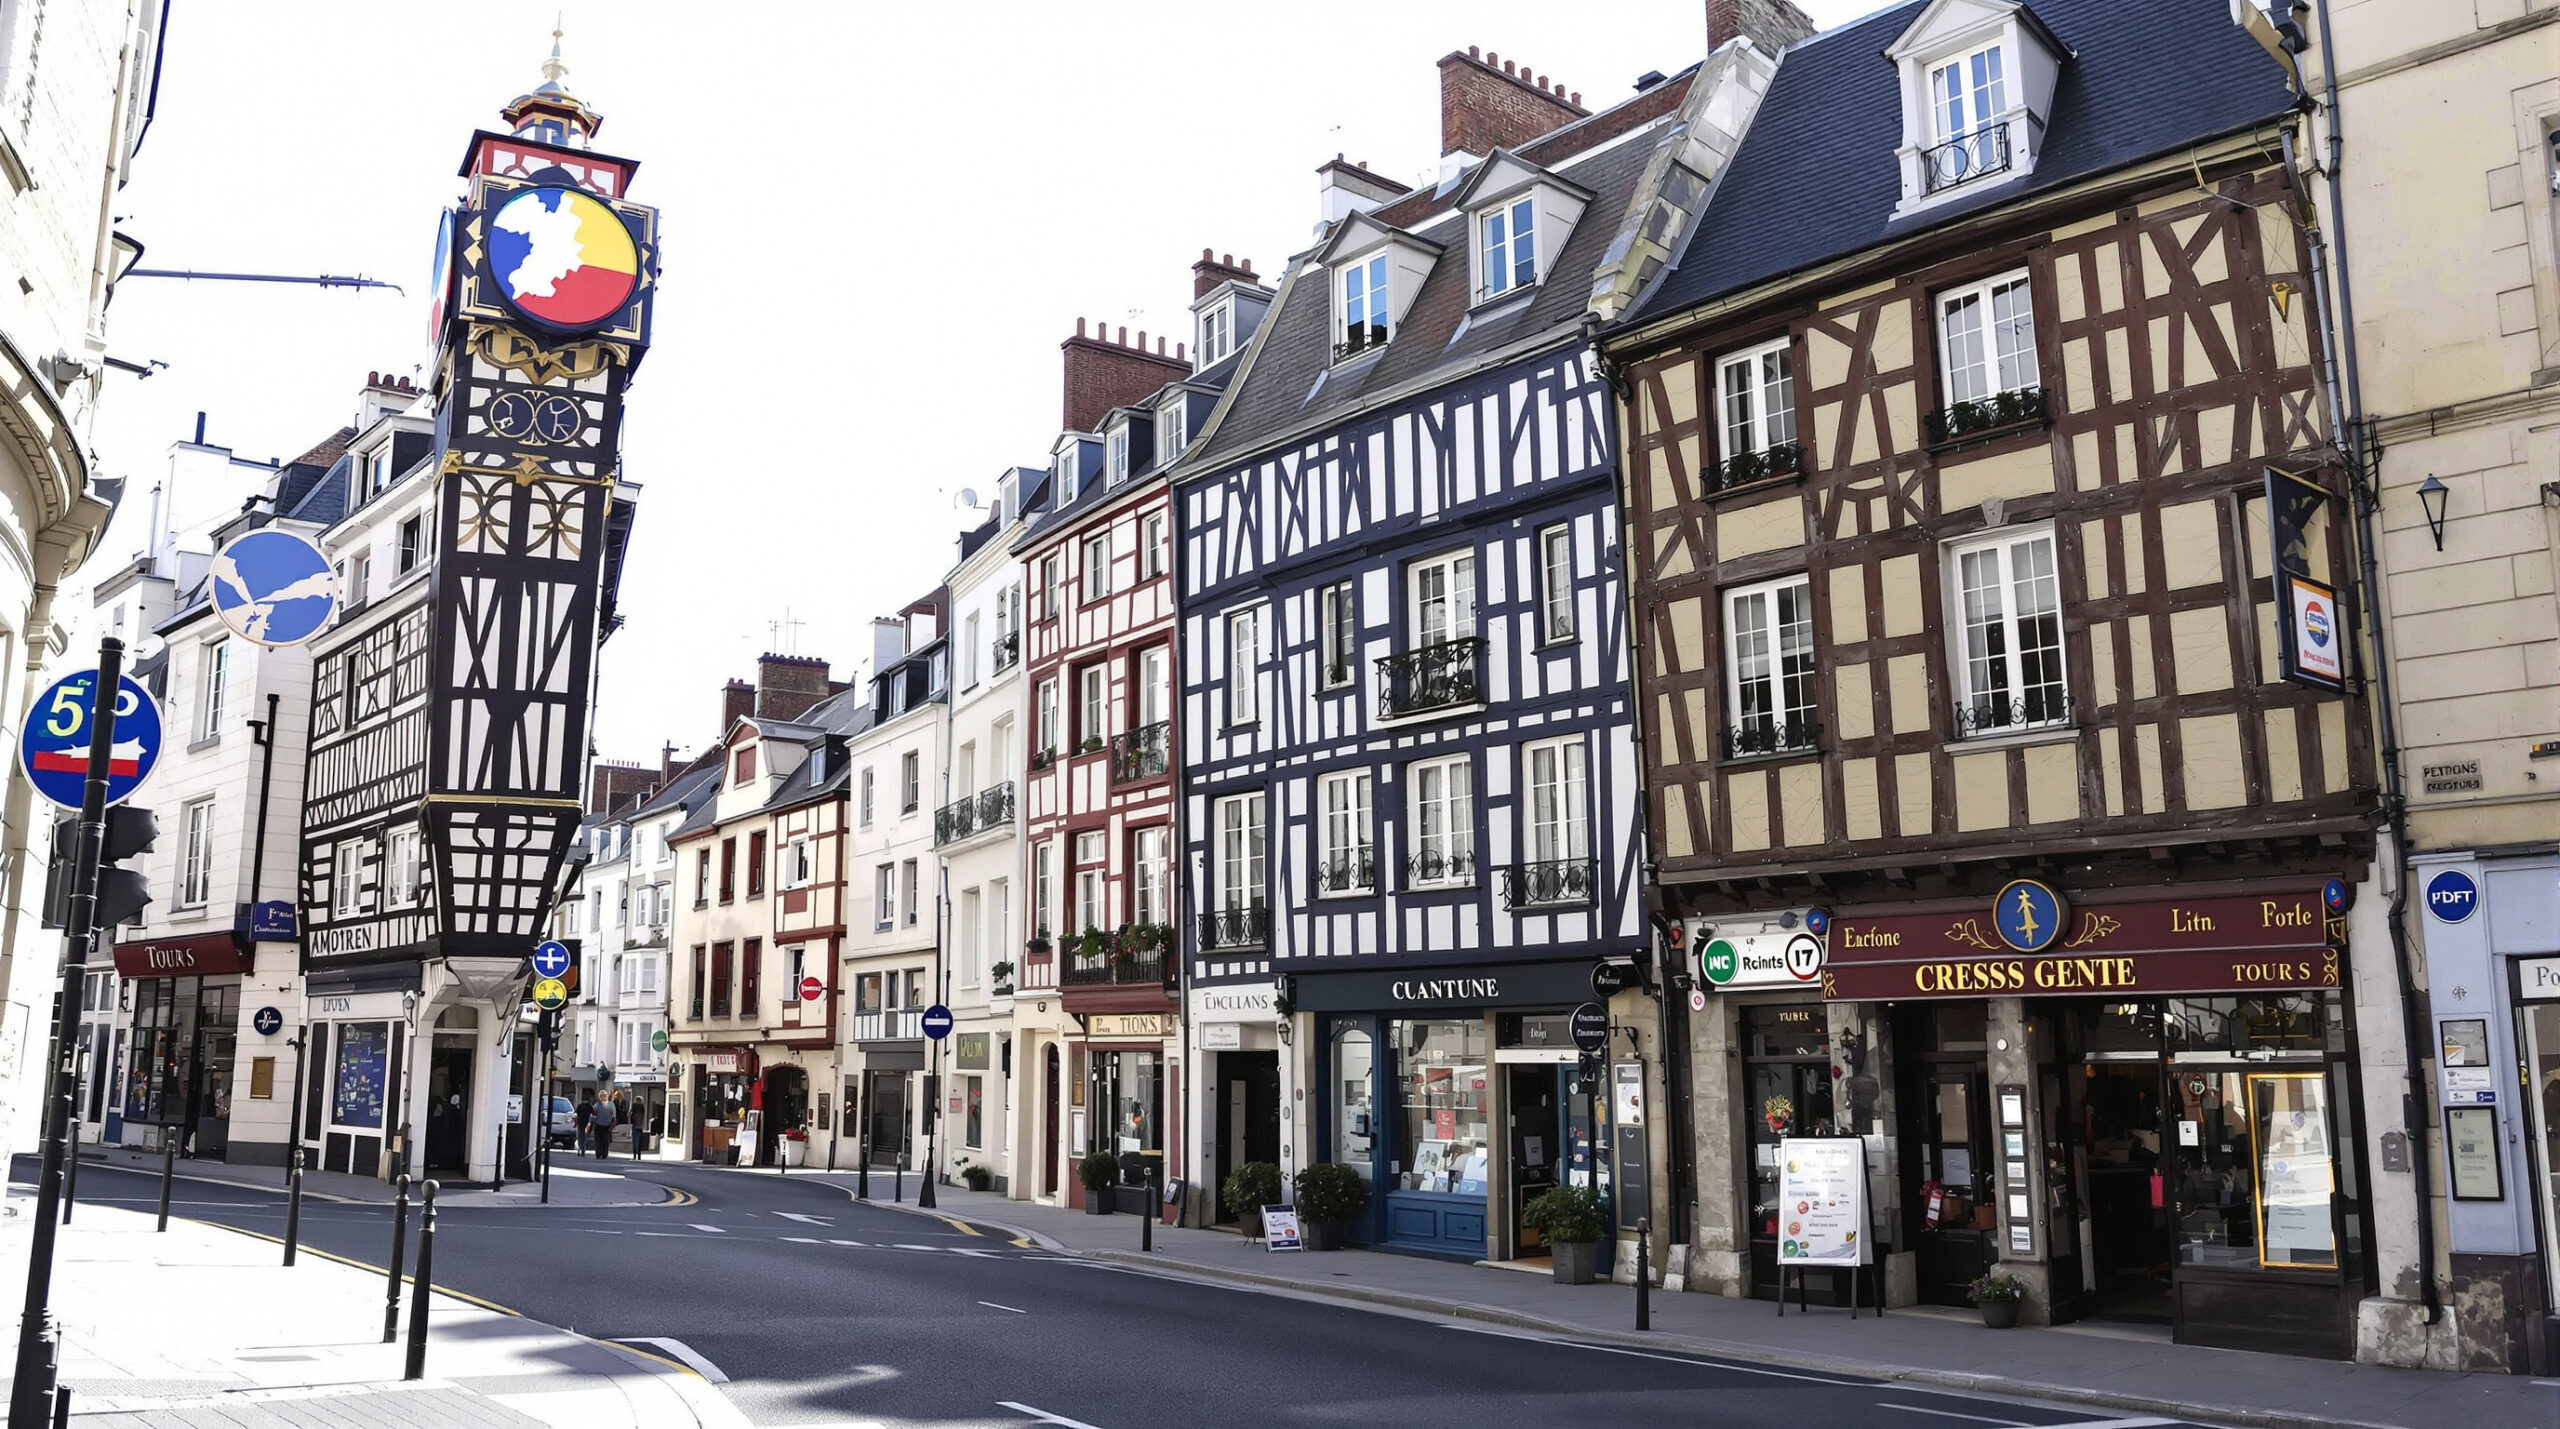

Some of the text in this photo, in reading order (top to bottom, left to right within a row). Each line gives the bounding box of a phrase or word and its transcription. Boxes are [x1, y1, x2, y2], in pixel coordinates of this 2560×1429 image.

[2261, 901, 2312, 928] Forle
[1795, 949, 1814, 967] 17
[1915, 958, 2136, 992] CRESSS GENTE
[1392, 978, 1499, 1000] CLANTUNE
